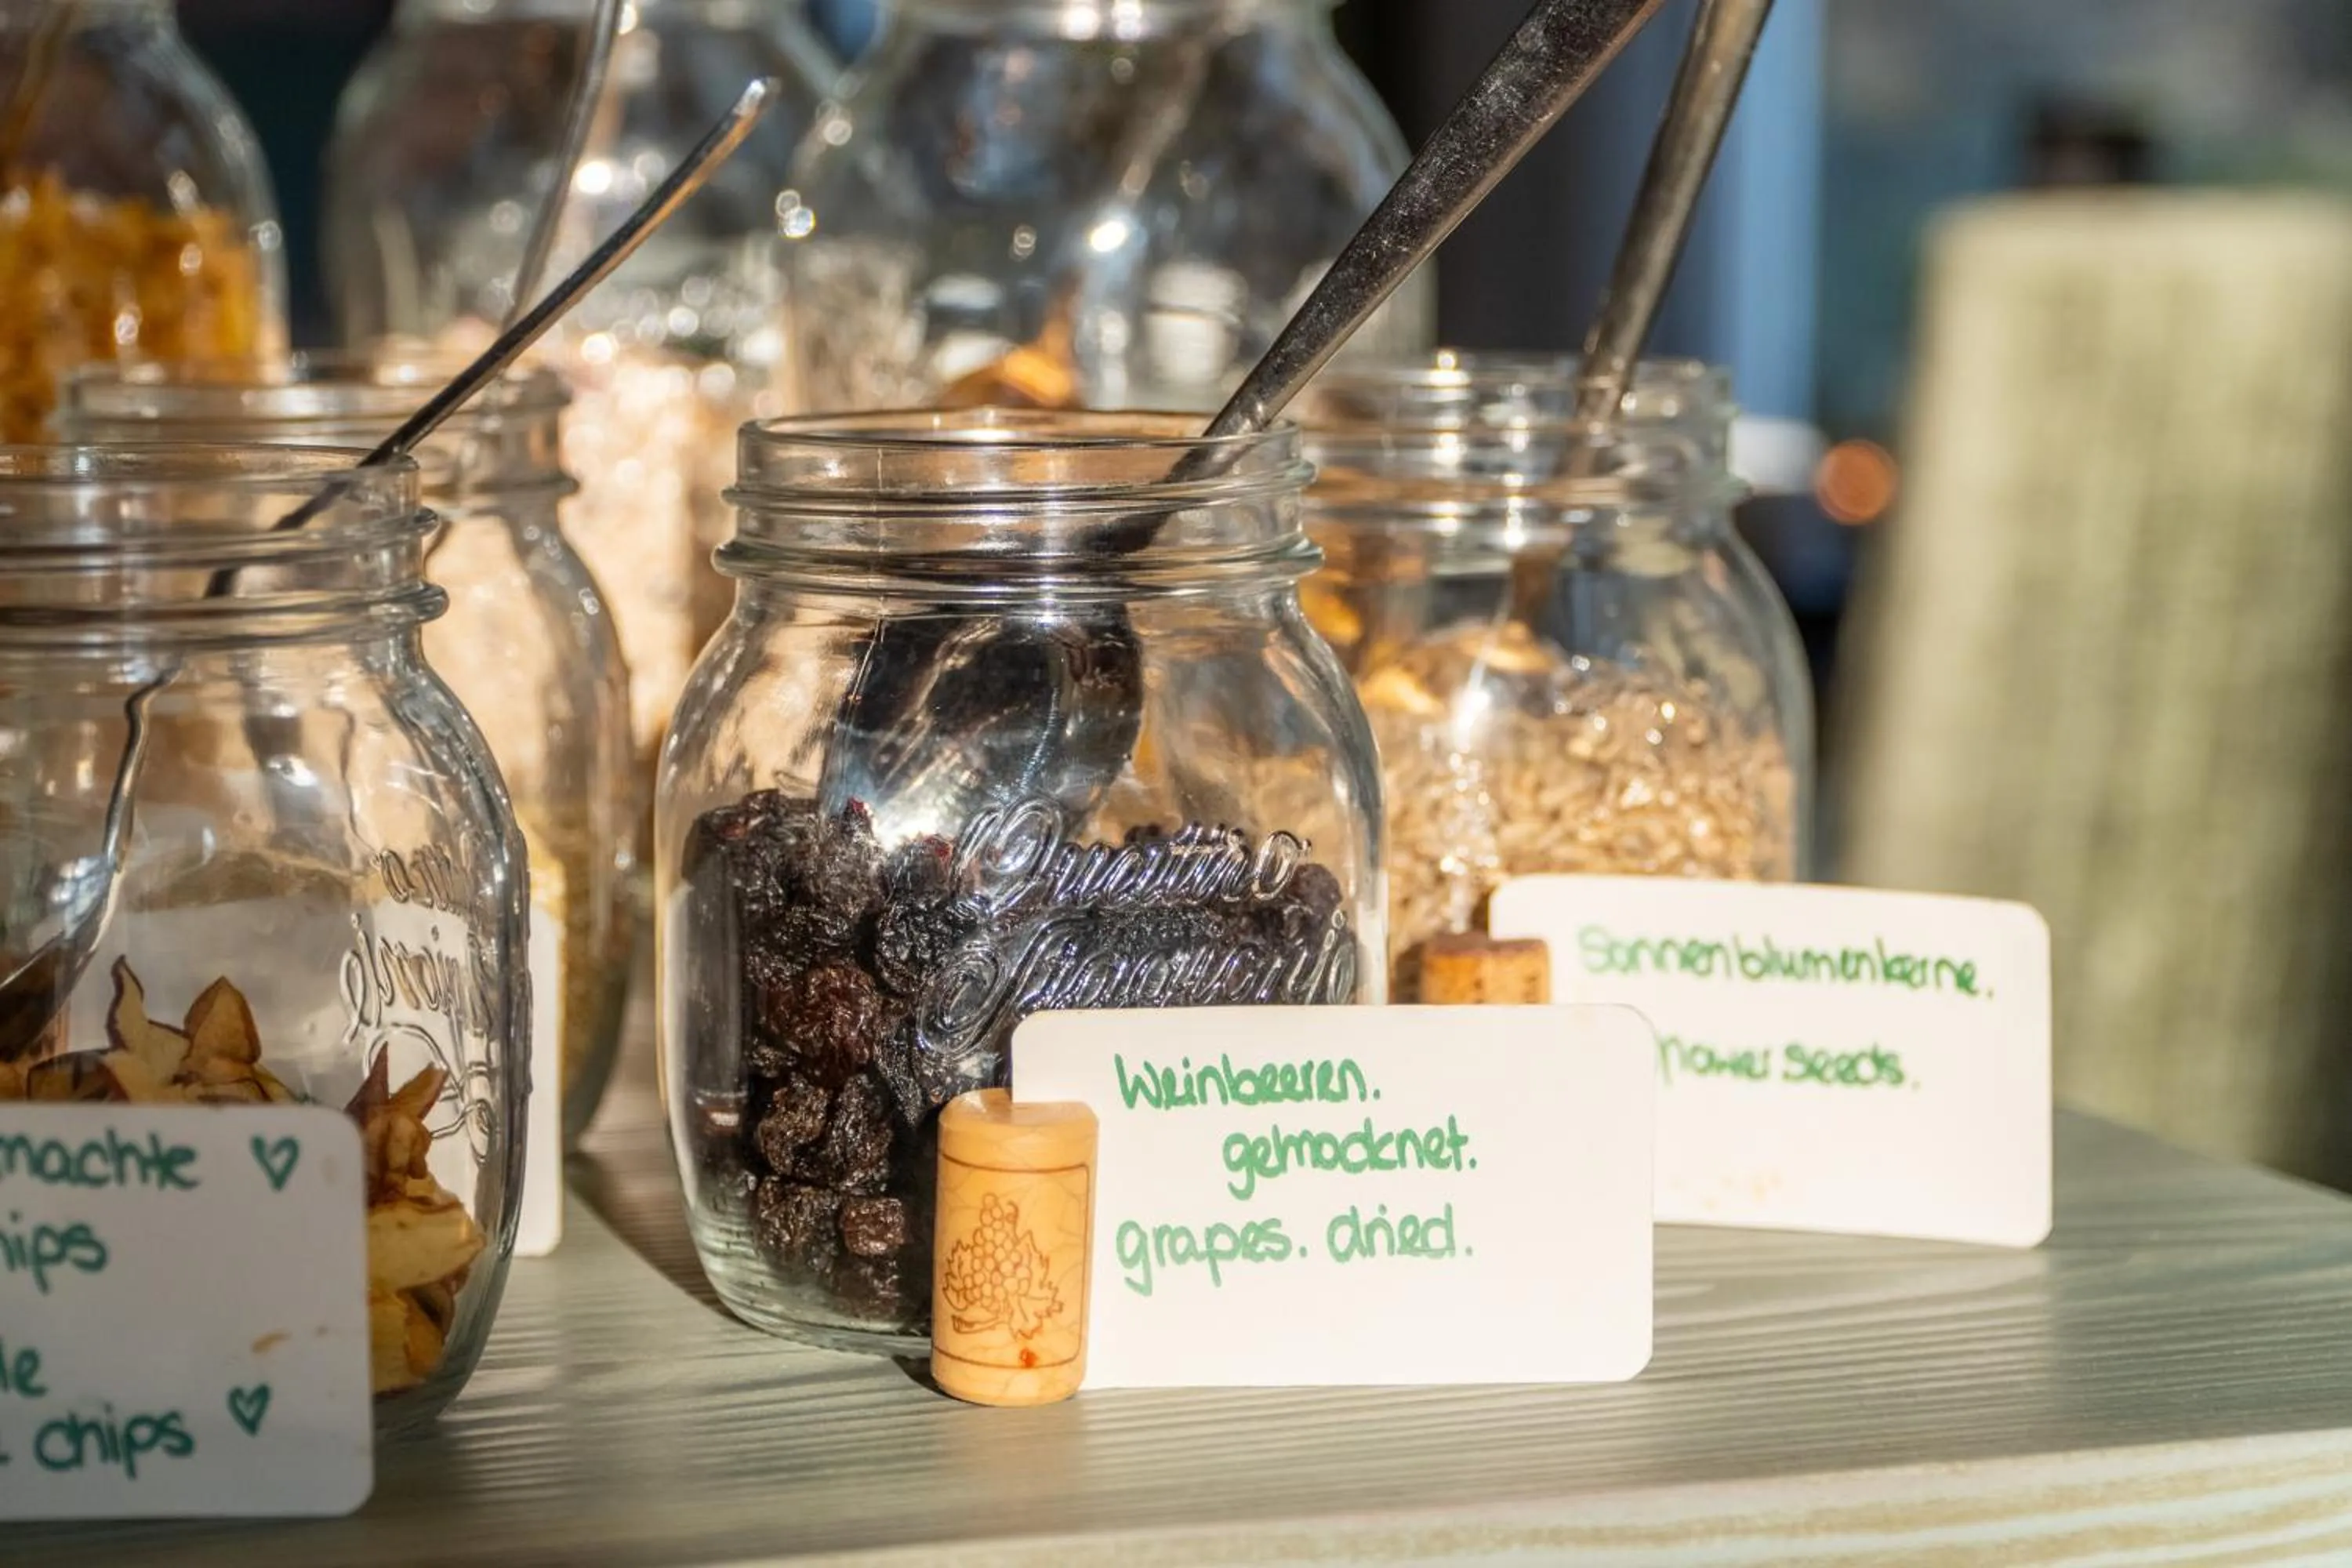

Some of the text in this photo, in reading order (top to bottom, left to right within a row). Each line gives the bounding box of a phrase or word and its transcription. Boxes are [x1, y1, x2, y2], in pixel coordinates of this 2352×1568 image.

[1113, 1053, 1381, 1112] Weinbeeren.
[1115, 1203, 1474, 1296] grapes. dried.
